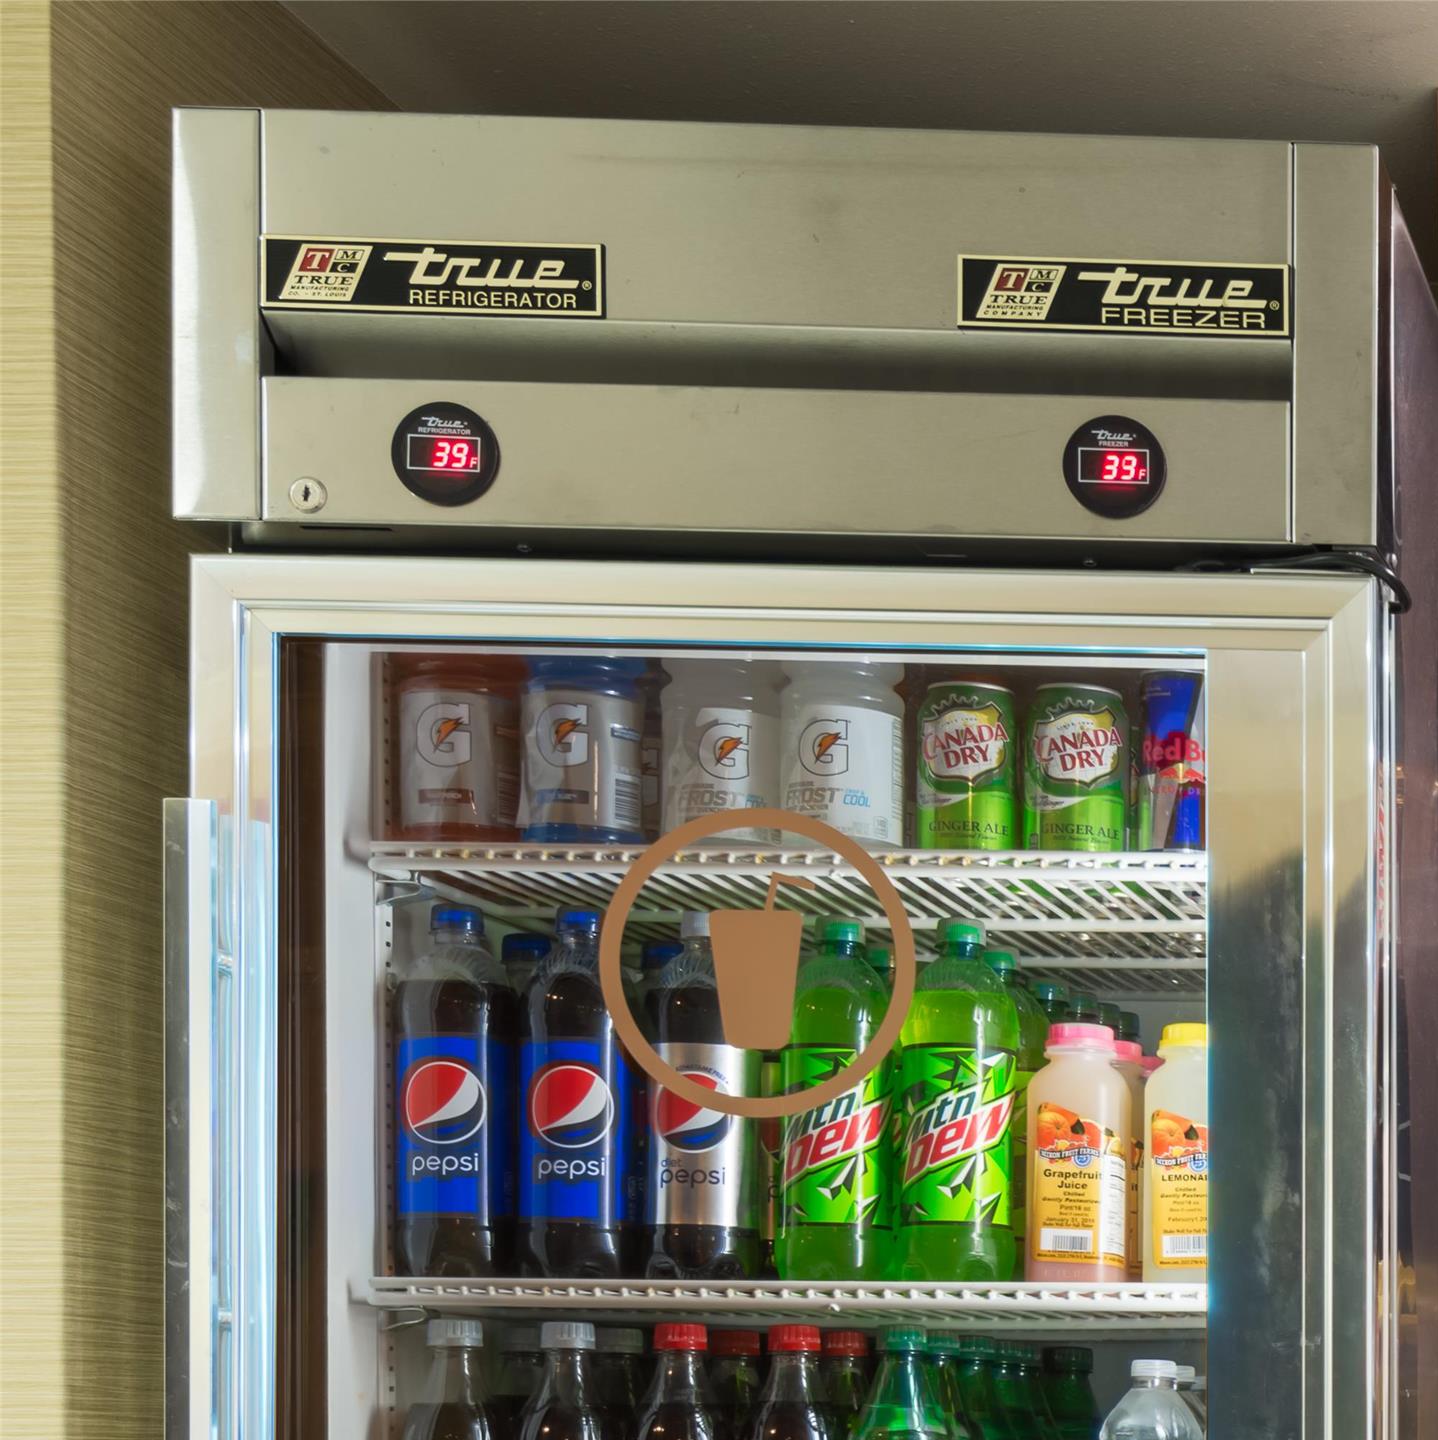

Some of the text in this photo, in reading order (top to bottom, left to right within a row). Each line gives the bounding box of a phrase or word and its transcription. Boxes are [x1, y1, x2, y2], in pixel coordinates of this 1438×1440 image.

[294, 275, 354, 287] TRUE
[410, 289, 577, 309] REFRIGERATOR
[990, 294, 1048, 305] TRUE
[1101, 308, 1266, 329] FREEZER
[418, 426, 471, 435] REFRIGERATOR
[922, 721, 1009, 762] CANADA
[1035, 726, 1122, 763] CANADA
[1142, 735, 1182, 763] Red
[943, 744, 991, 769] DRY
[1059, 747, 1106, 772] DRY
[929, 820, 1009, 836] GINGER ALE
[1097, 825, 1120, 840] ALE
[411, 1152, 479, 1177] pepsi
[537, 1156, 606, 1180] pepsi
[661, 1157, 682, 1168] diet
[660, 1166, 726, 1189] pepsi
[1043, 1168, 1102, 1180] Grapefruit
[1057, 1181, 1088, 1190] Juice
